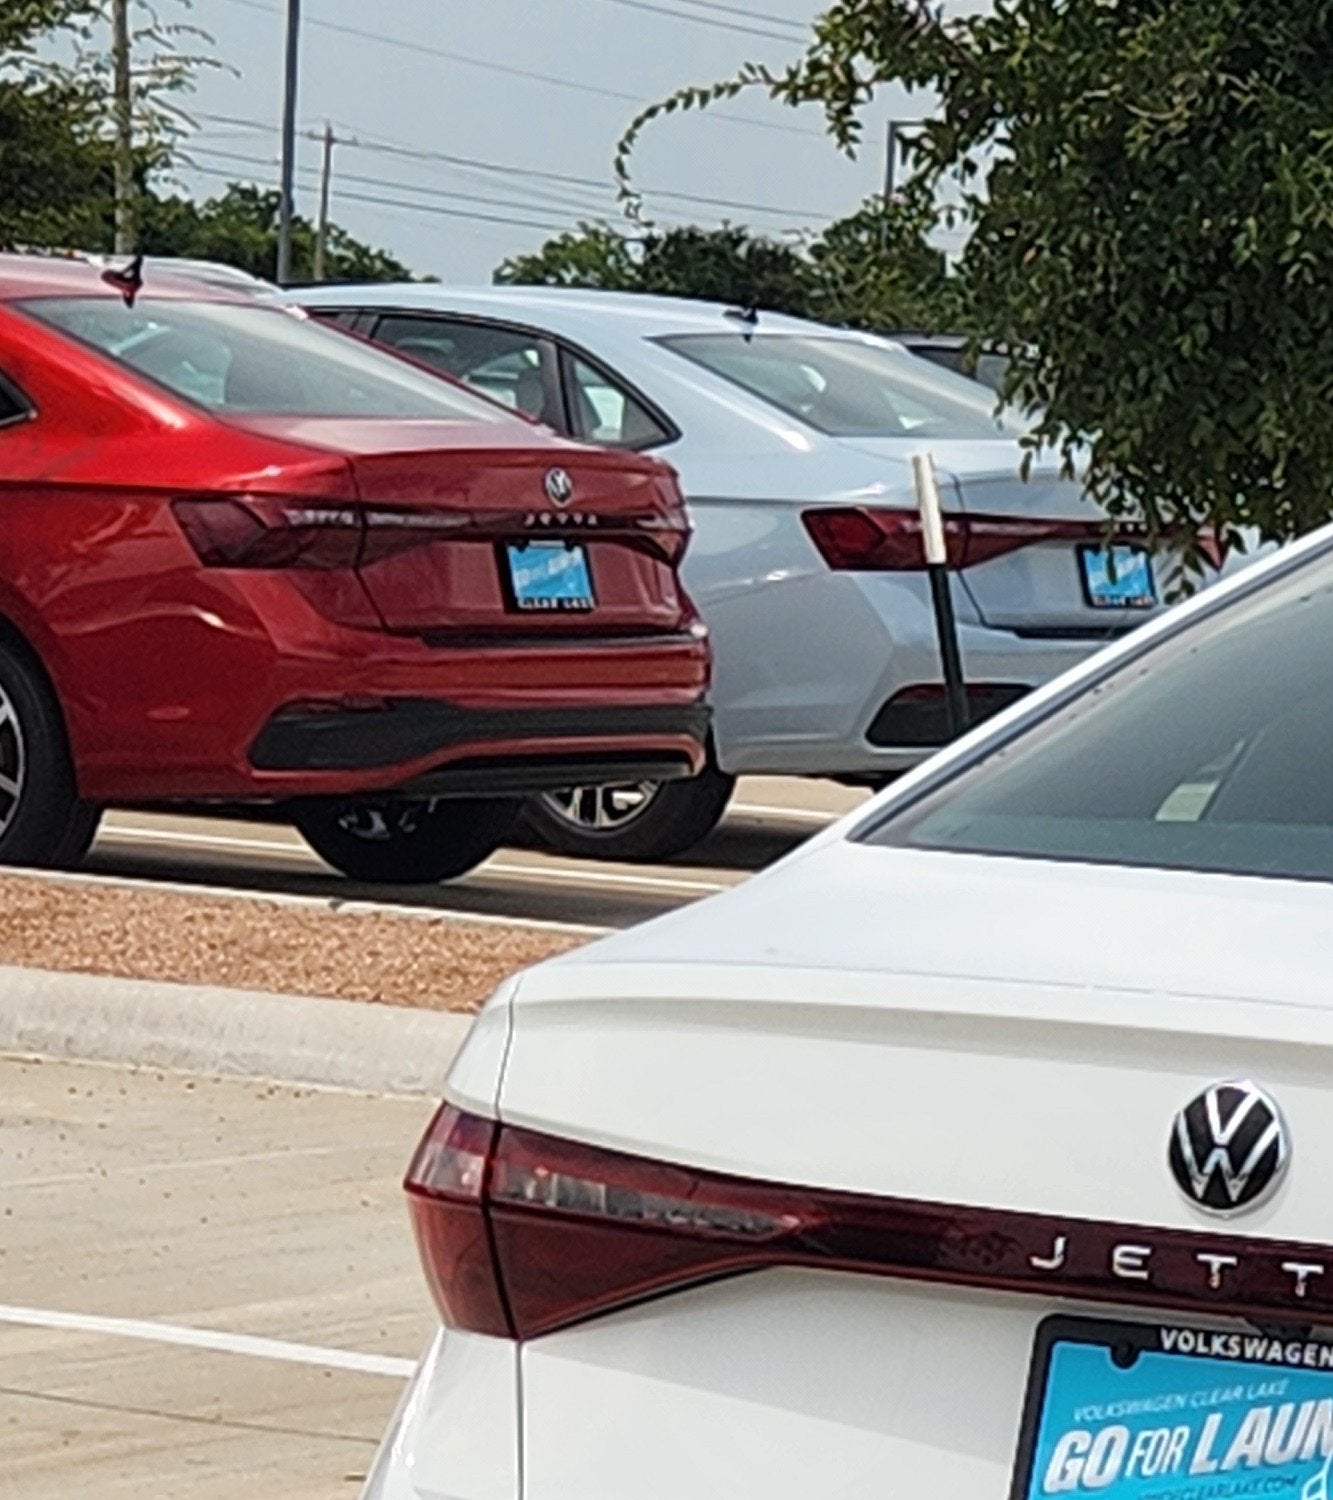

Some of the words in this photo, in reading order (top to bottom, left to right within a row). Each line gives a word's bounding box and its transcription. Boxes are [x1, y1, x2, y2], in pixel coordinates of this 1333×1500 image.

[1073, 1391, 1189, 1422] VOLKSWAGEN
[1190, 1383, 1244, 1409] CLEAR
[1246, 1377, 1291, 1401] LAKE
[1043, 1425, 1128, 1494] GO
[1126, 1425, 1186, 1478] FOR
